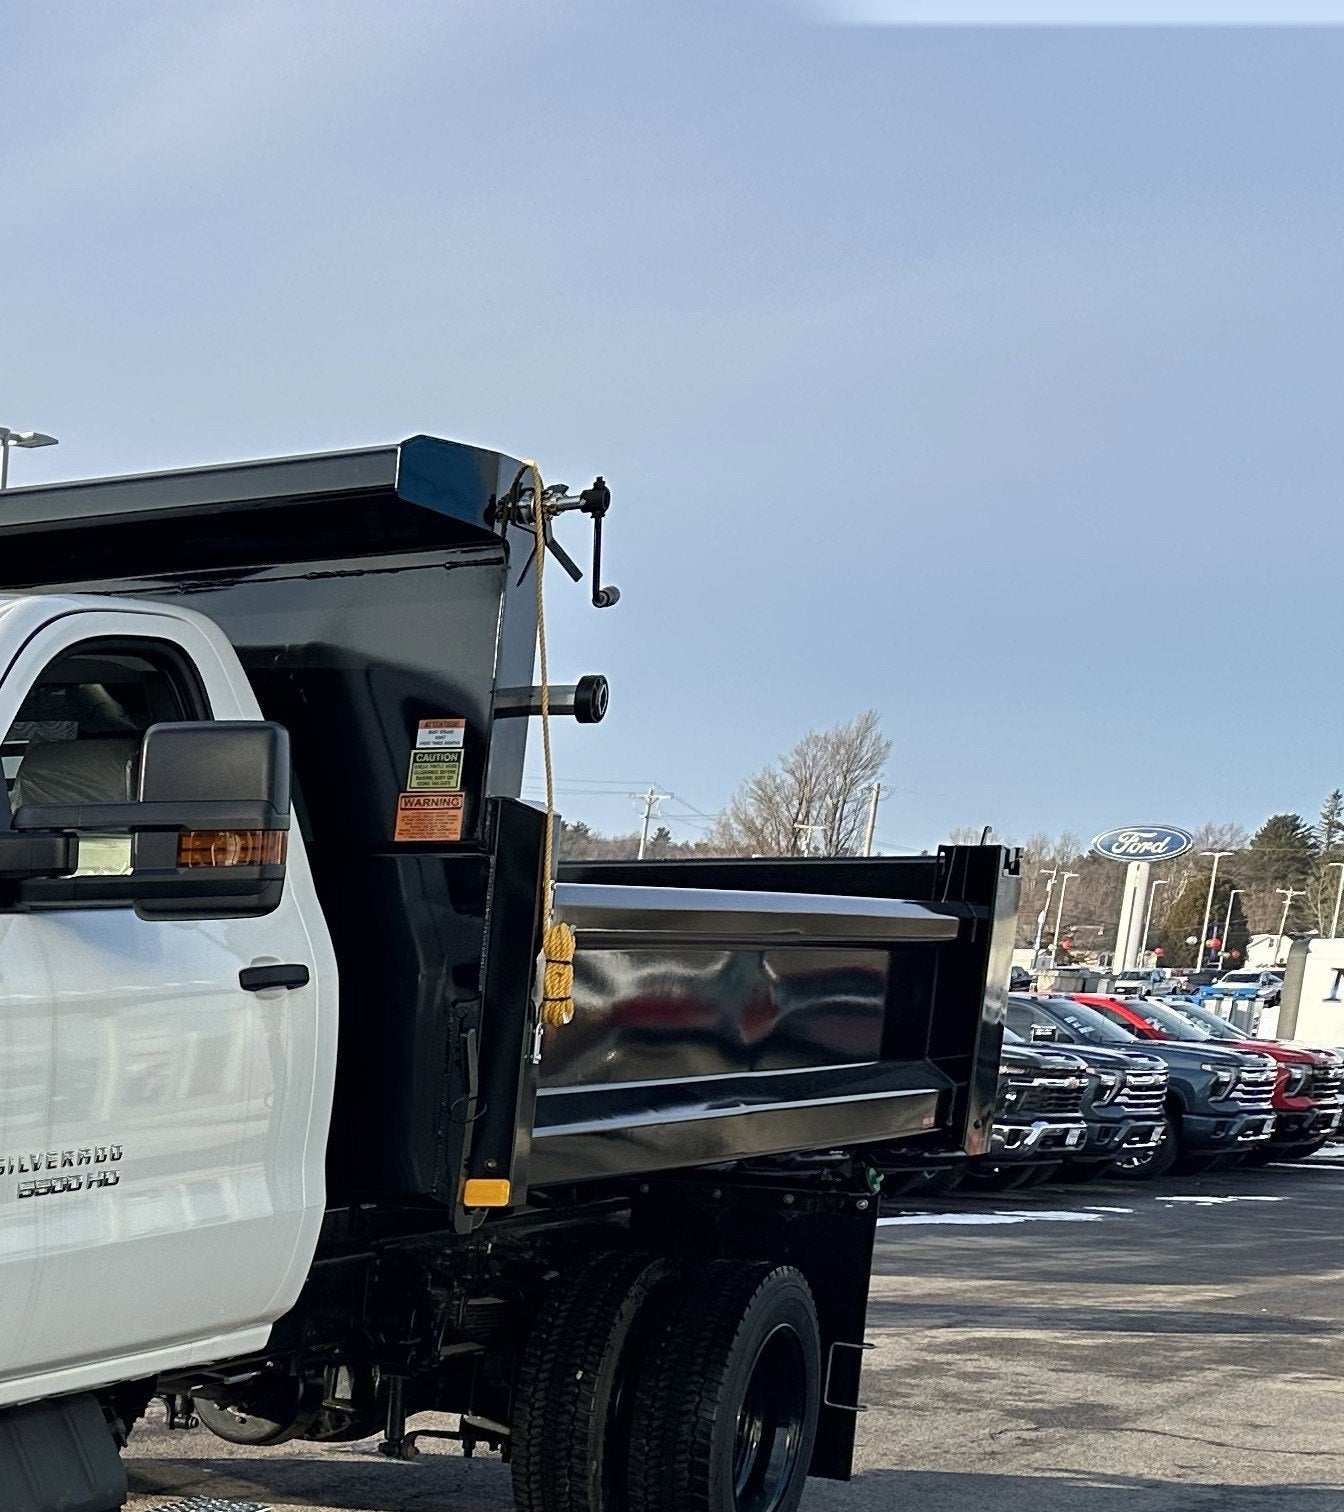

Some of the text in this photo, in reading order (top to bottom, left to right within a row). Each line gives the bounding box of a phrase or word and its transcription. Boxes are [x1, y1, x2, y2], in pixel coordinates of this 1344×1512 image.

[415, 753, 459, 762] CAUTION
[403, 798, 460, 808] WARNING
[1111, 831, 1172, 854] Ford
